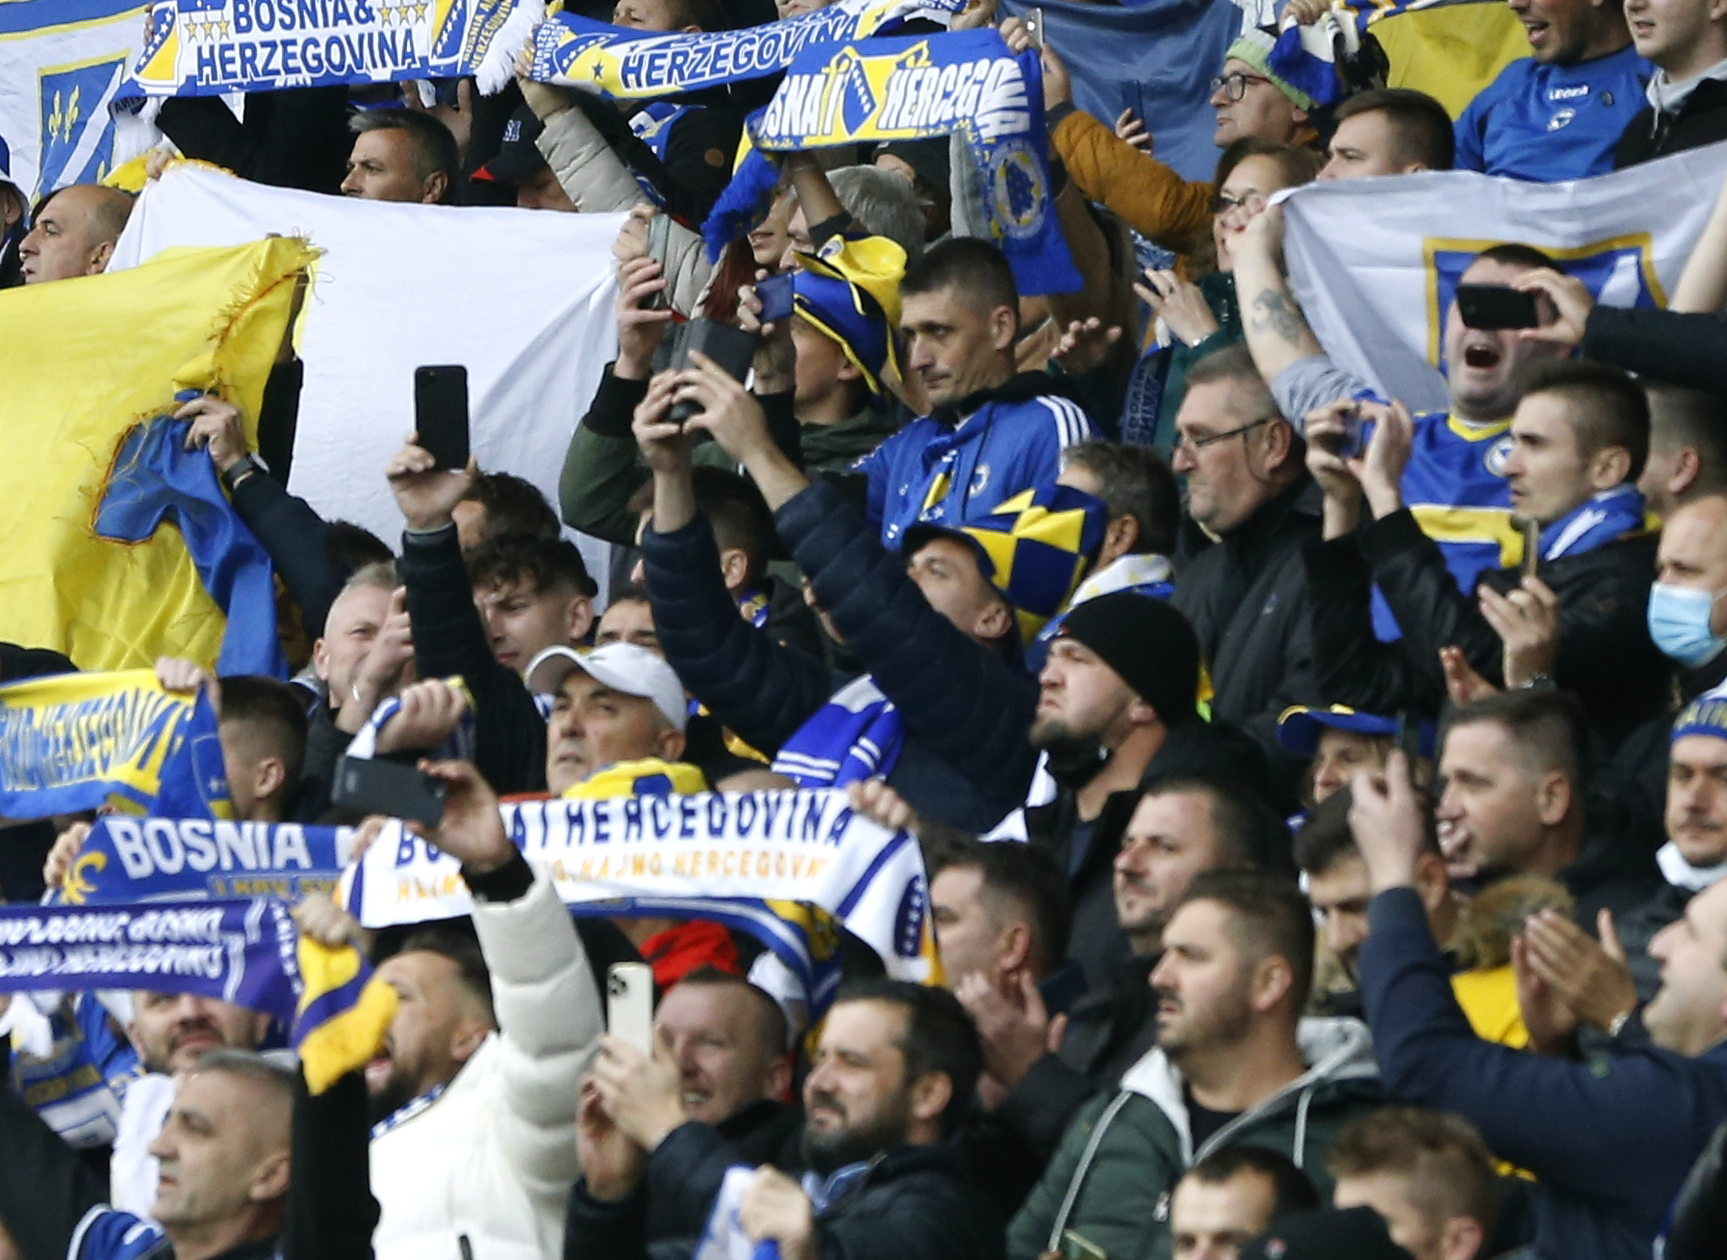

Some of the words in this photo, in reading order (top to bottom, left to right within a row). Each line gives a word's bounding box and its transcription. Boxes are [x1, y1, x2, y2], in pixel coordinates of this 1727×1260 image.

[195, 29, 419, 86] HERZEGOVINA
[565, 788, 860, 846] HERCEGOVINA
[104, 818, 314, 880] BOSNIA
